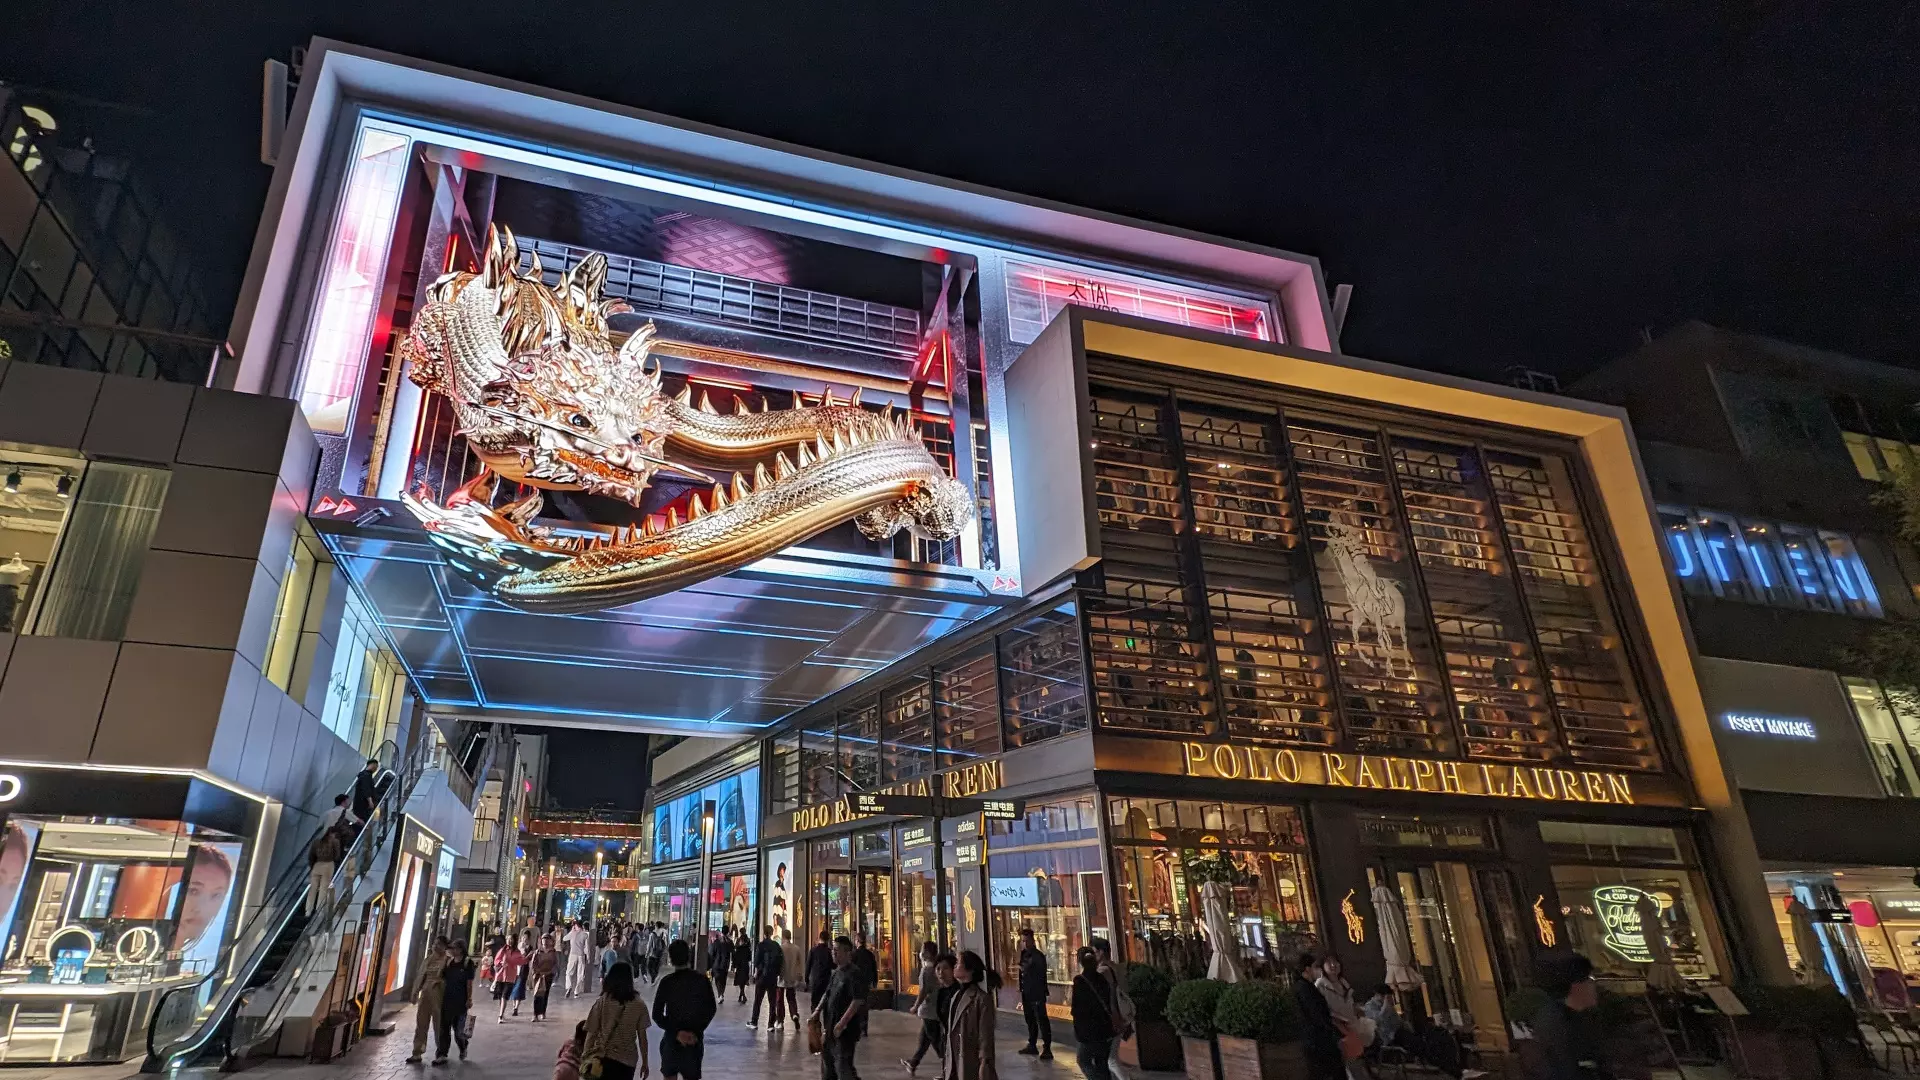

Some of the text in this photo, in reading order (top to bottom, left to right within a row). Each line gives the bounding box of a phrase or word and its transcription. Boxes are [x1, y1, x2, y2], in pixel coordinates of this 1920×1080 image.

[1087, 279, 1109, 305] TAI
[1727, 714, 1816, 738] ISSEY MIYAKE
[1182, 742, 1635, 805] POLO RALPH LAUREN
[859, 795, 876, 805] 西区
[792, 804, 829, 833] POLO
[957, 820, 976, 833] adidas
[1605, 893, 1612, 901] A
[1612, 893, 1628, 901] CUP
